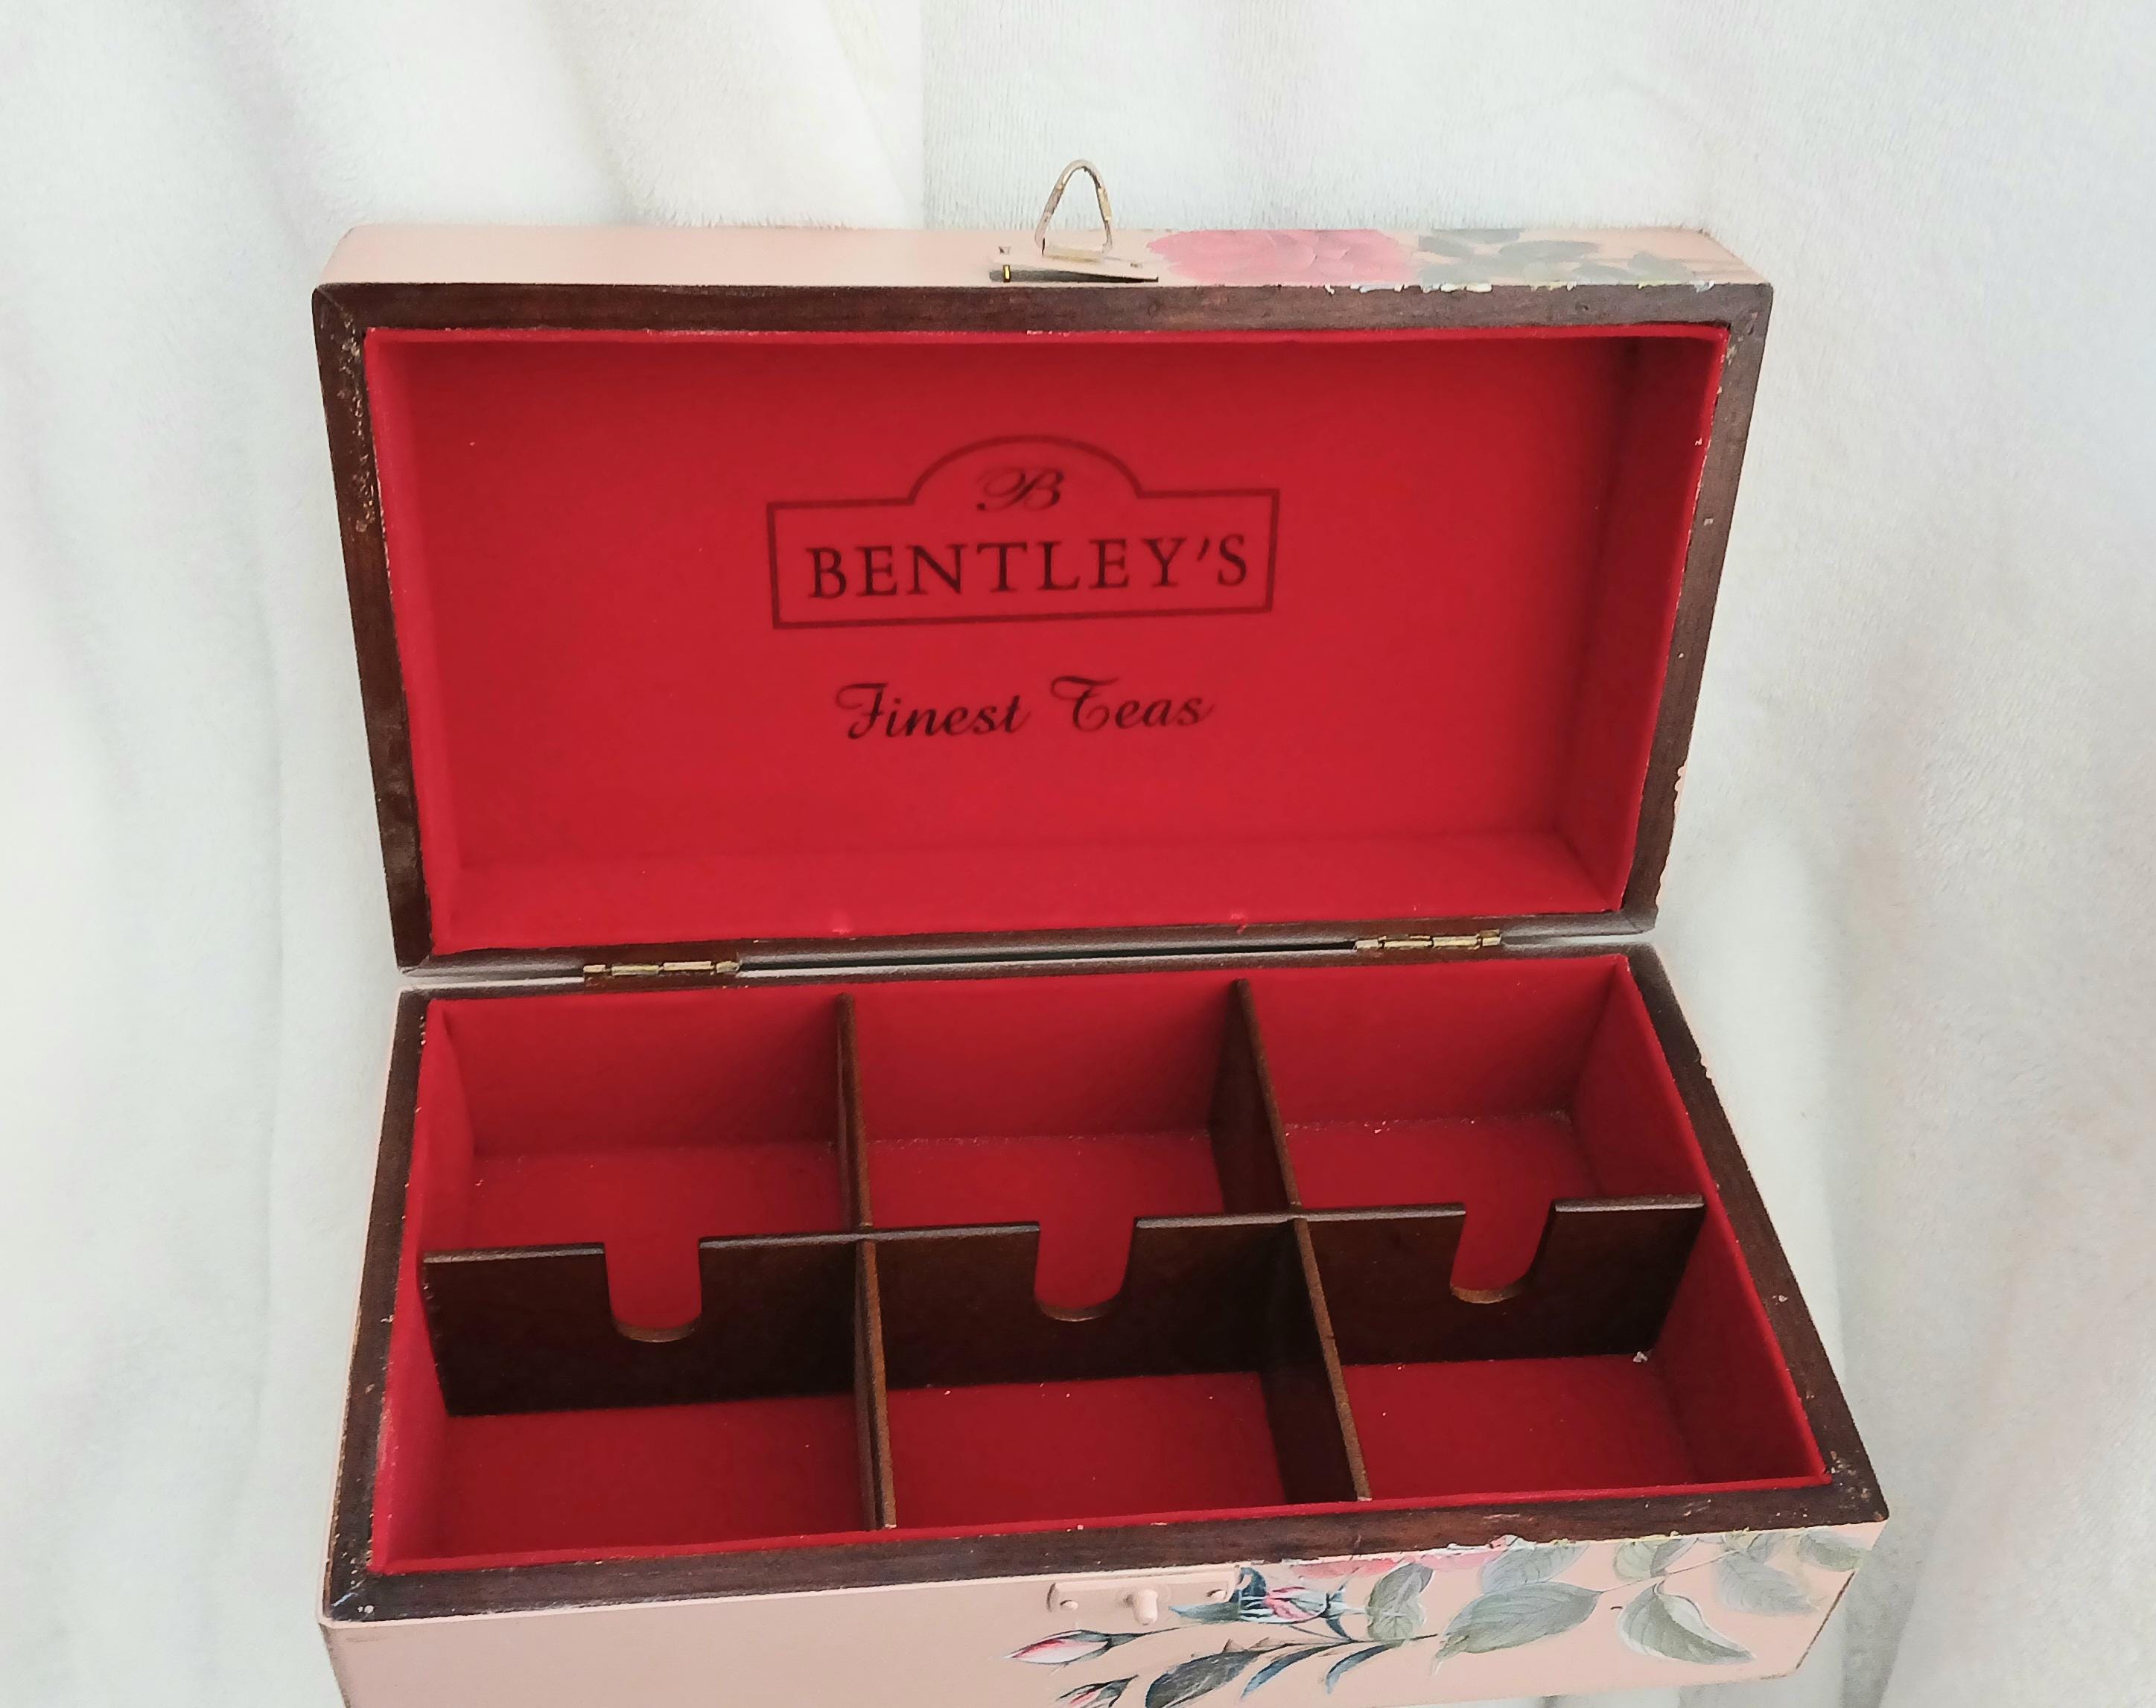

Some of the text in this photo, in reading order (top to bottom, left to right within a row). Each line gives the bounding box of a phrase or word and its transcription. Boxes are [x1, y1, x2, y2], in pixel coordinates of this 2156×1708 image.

[976, 467, 1065, 512] B
[806, 533, 1249, 599] BENTLEY'S
[835, 675, 1216, 740] Finest Teas
